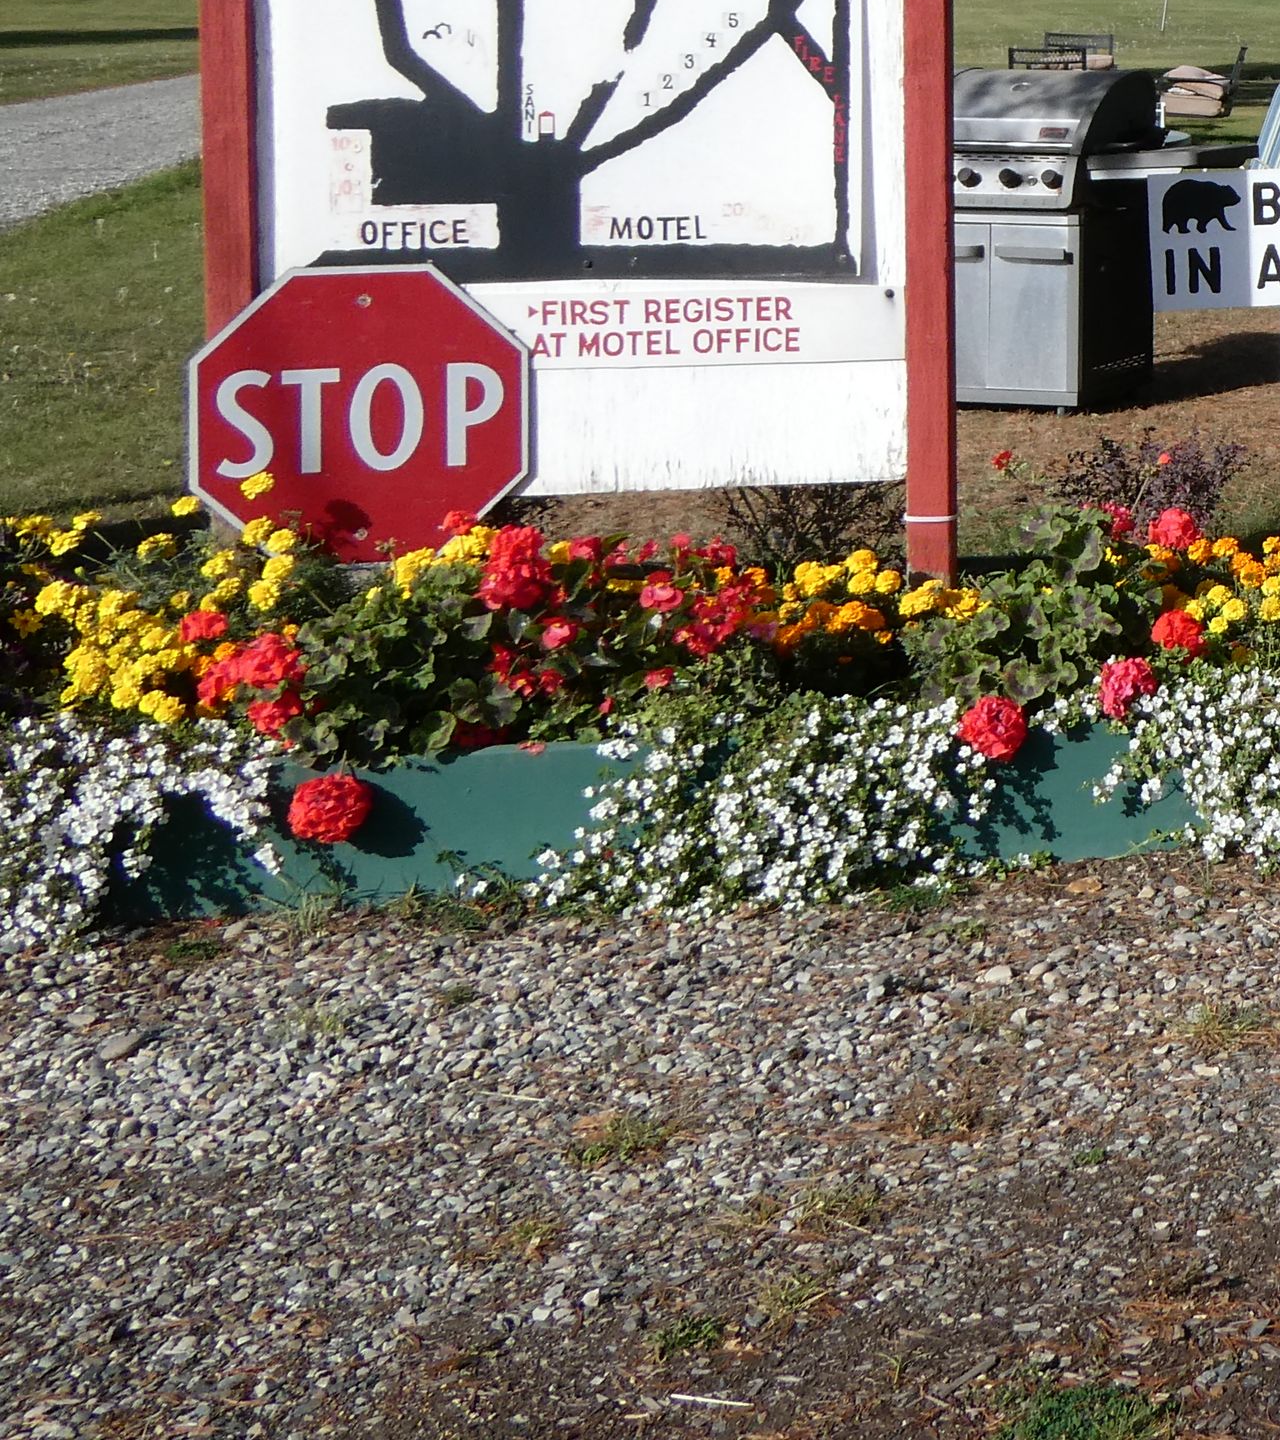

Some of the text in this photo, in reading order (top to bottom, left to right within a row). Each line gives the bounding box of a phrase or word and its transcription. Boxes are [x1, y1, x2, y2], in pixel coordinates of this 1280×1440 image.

[642, 14, 739, 106] 1 2 3 4 5
[794, 35, 835, 83] FIRE
[525, 84, 535, 134] SANI
[361, 219, 470, 248] OFFICE
[610, 215, 707, 241] MOTEL
[1165, 247, 1221, 295] IN
[541, 296, 793, 325] FIRST REGISTER
[531, 327, 800, 357] AT MOTEL OFFICE
[215, 362, 504, 479] STOP
